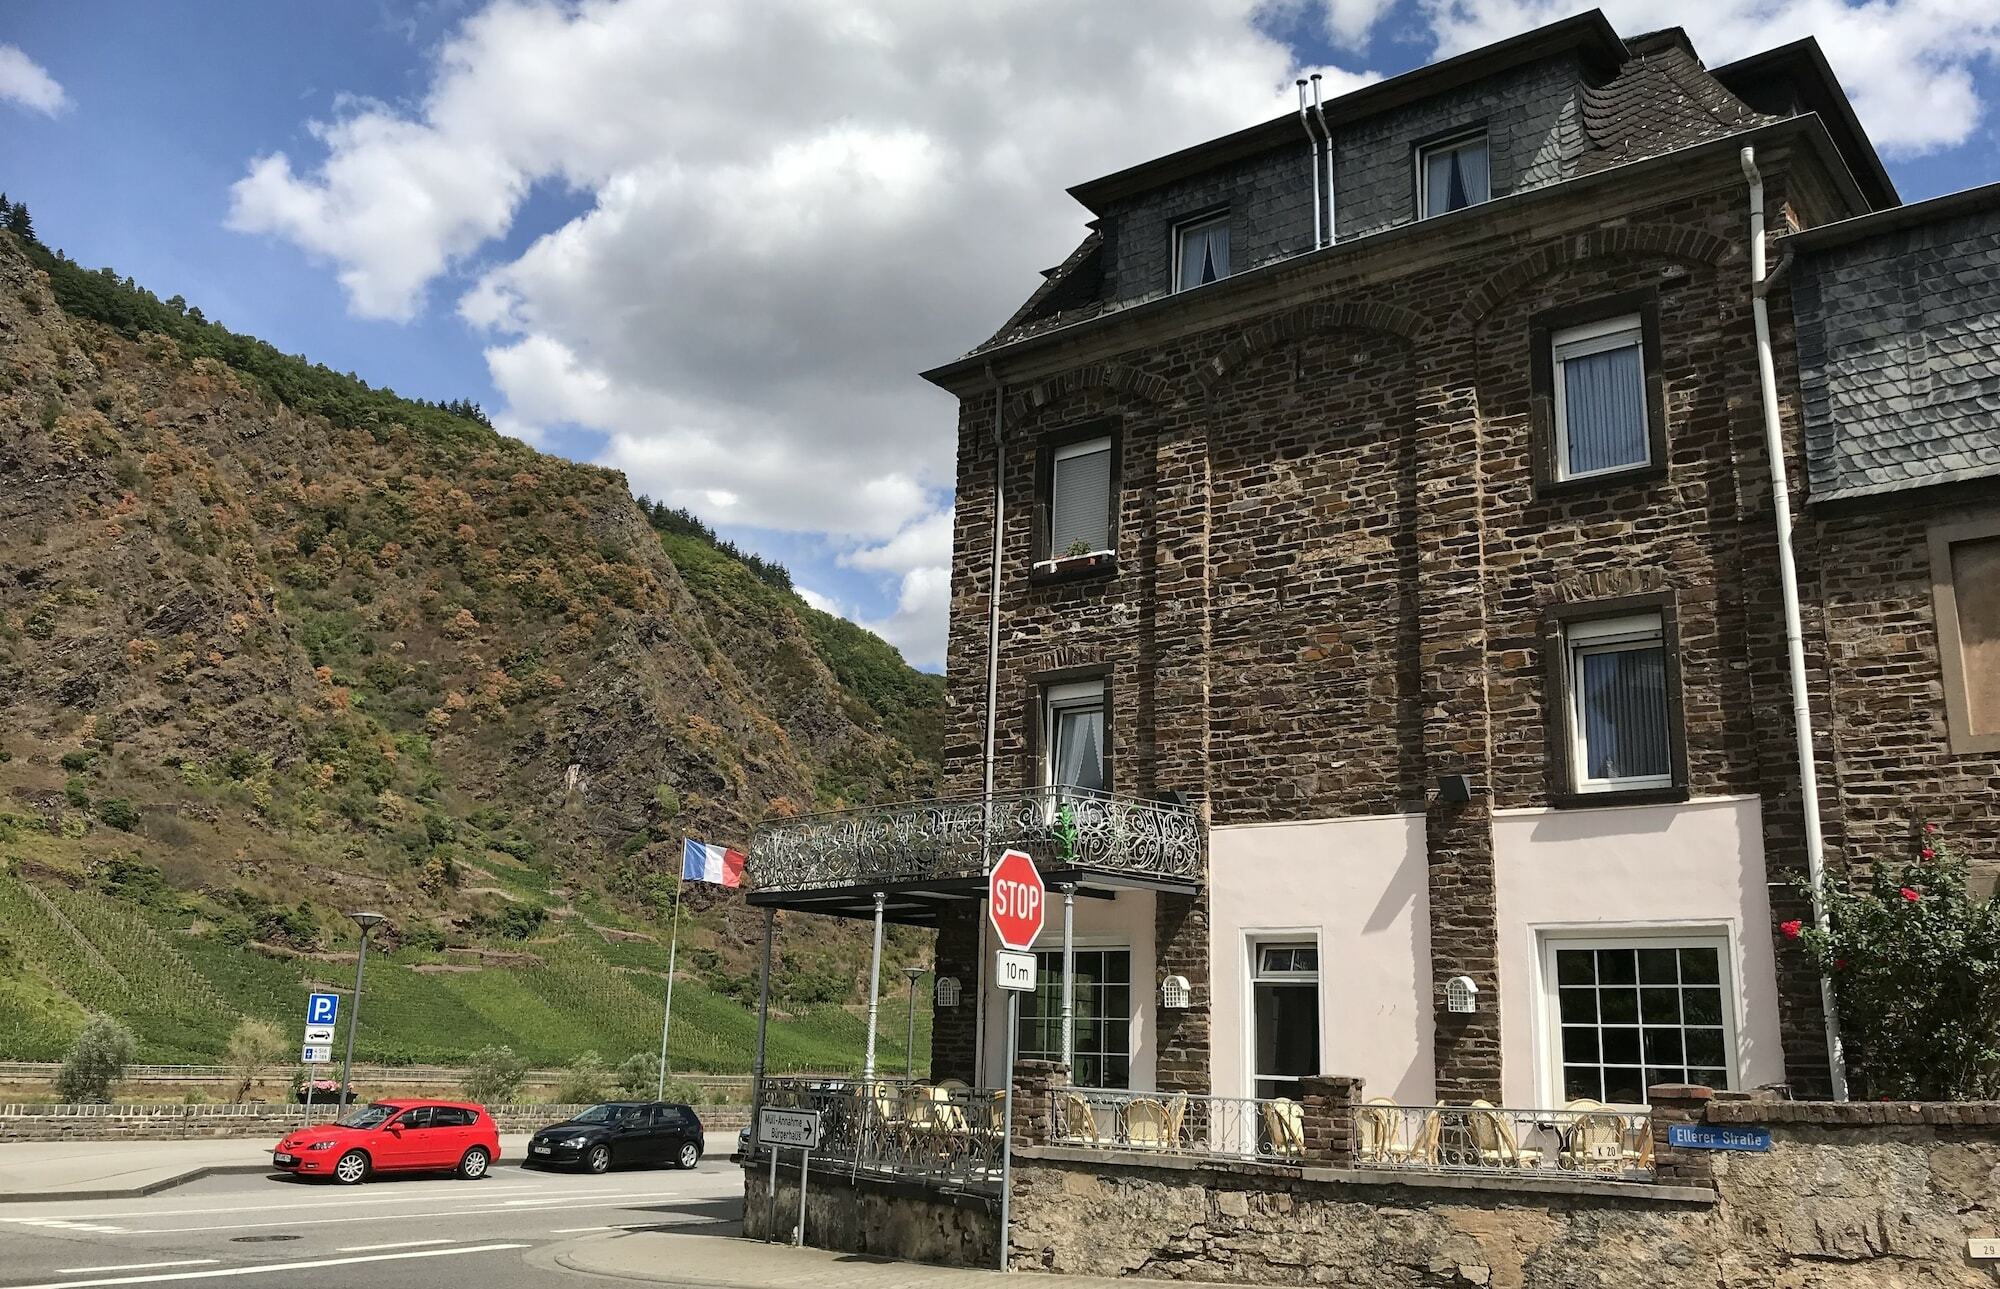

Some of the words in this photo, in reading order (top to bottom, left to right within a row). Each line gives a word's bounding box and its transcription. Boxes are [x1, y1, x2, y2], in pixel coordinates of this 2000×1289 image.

[995, 879, 1039, 921] STOP
[314, 998, 331, 1021] P
[765, 1113, 802, 1128] Müll-Annahme
[771, 1127, 801, 1141] Bürgerhaus
[1676, 1128, 1716, 1145] Ellerer
[1722, 1131, 1762, 1146] Straße
[1598, 1147, 1603, 1157] K
[1606, 1146, 1616, 1157] 20
[1983, 1245, 1995, 1255] 29
